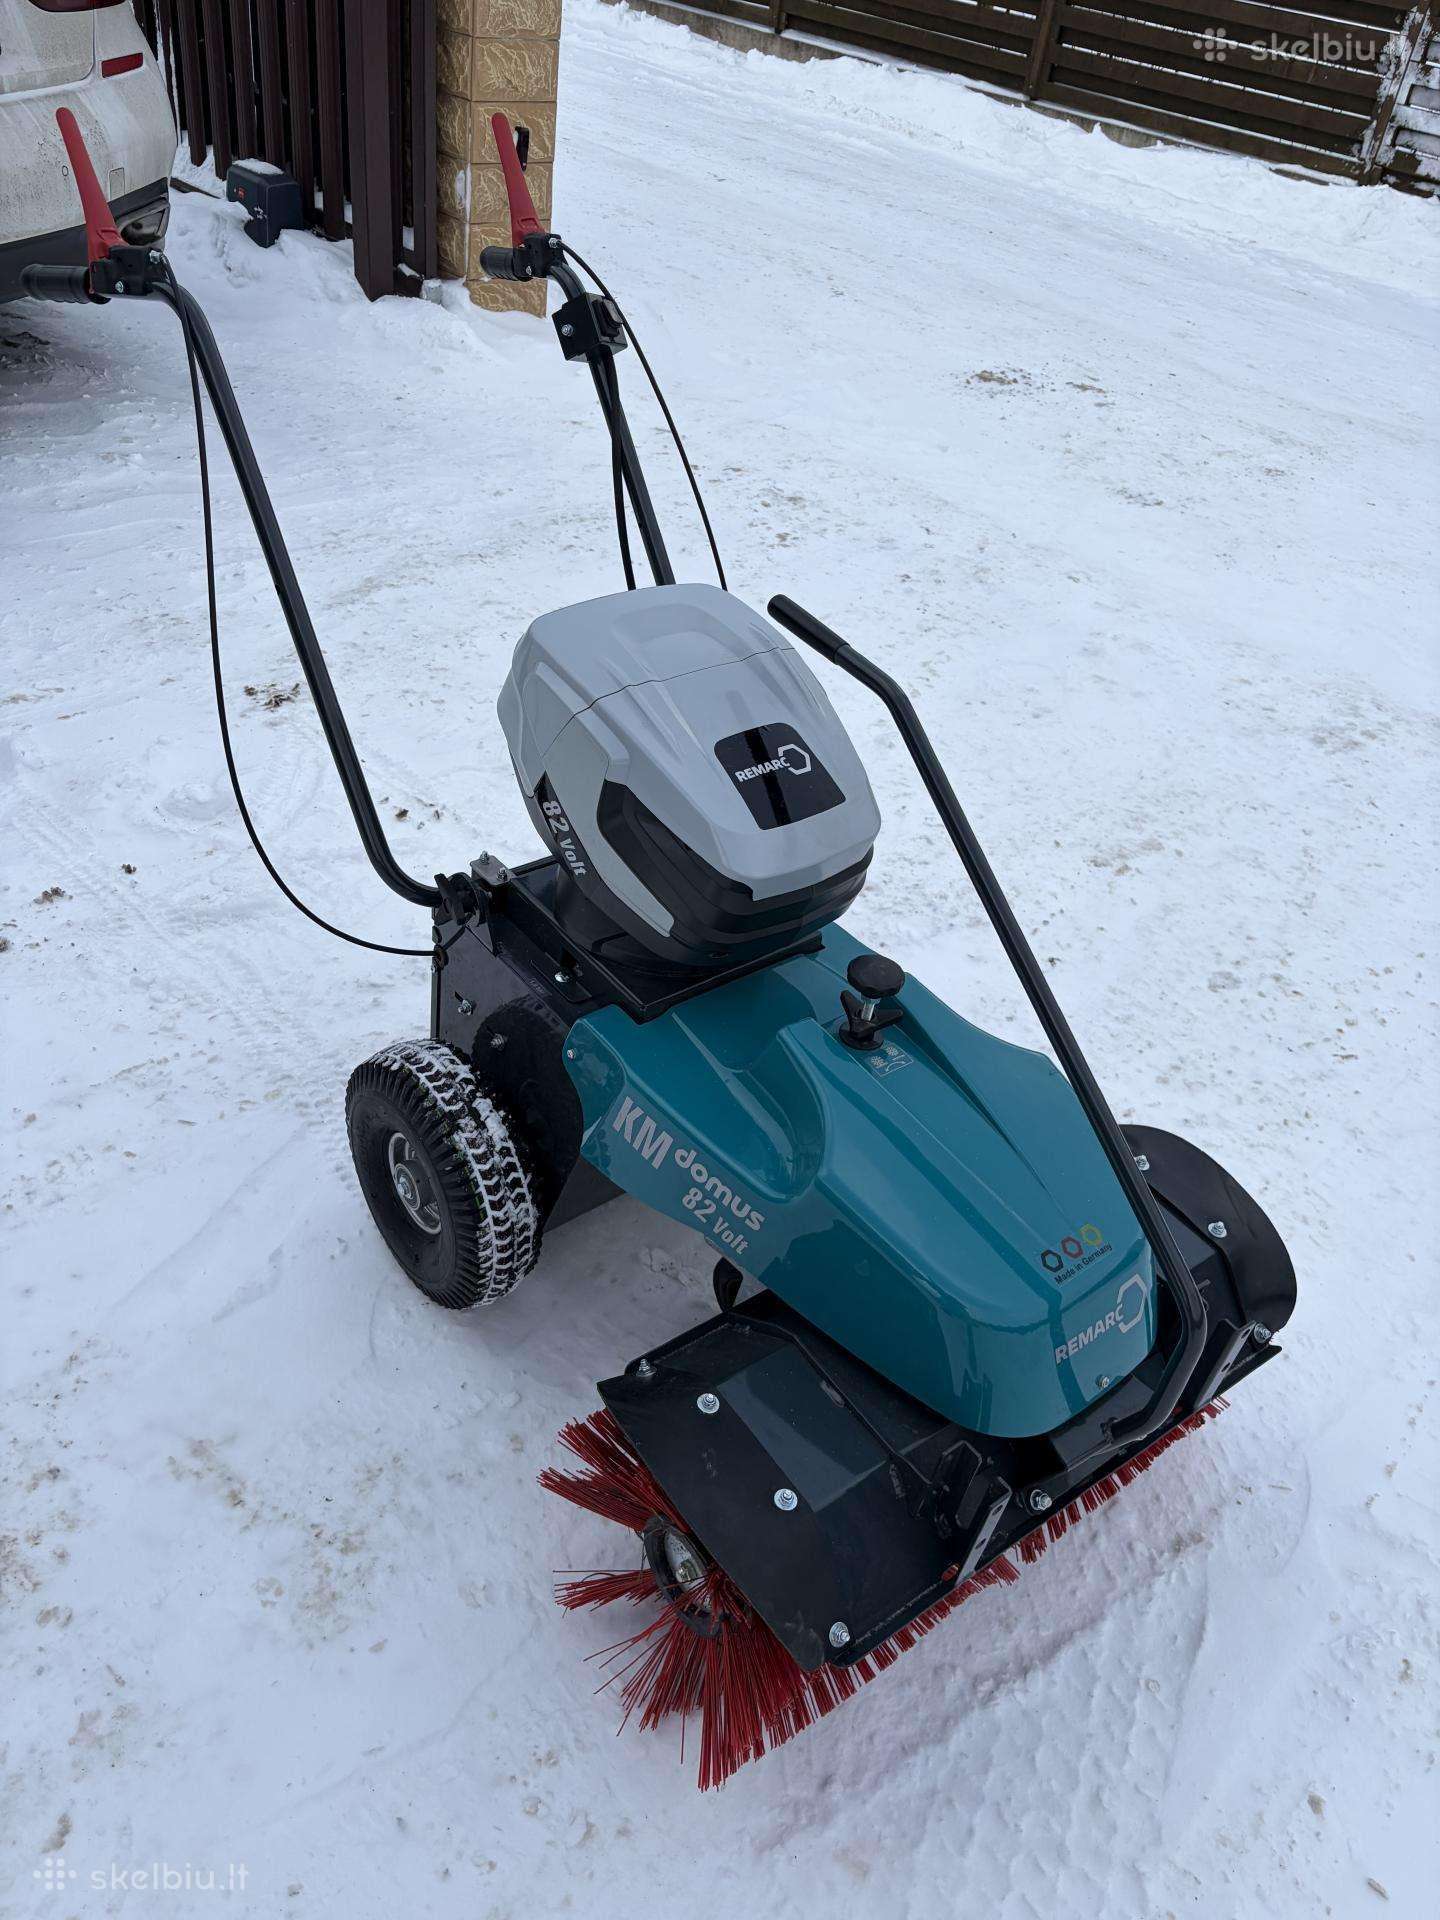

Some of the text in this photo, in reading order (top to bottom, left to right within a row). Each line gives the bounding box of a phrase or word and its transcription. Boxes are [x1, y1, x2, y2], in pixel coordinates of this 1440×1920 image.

[735, 757, 790, 782] REMARC
[542, 800, 587, 876] 82 Volt
[612, 1096, 766, 1231] KM domus
[682, 1187, 749, 1255] 82 Volt
[1054, 1267, 1076, 1284] Made
[1082, 1243, 1113, 1265] Germany
[1055, 1304, 1124, 1364] REMARC
